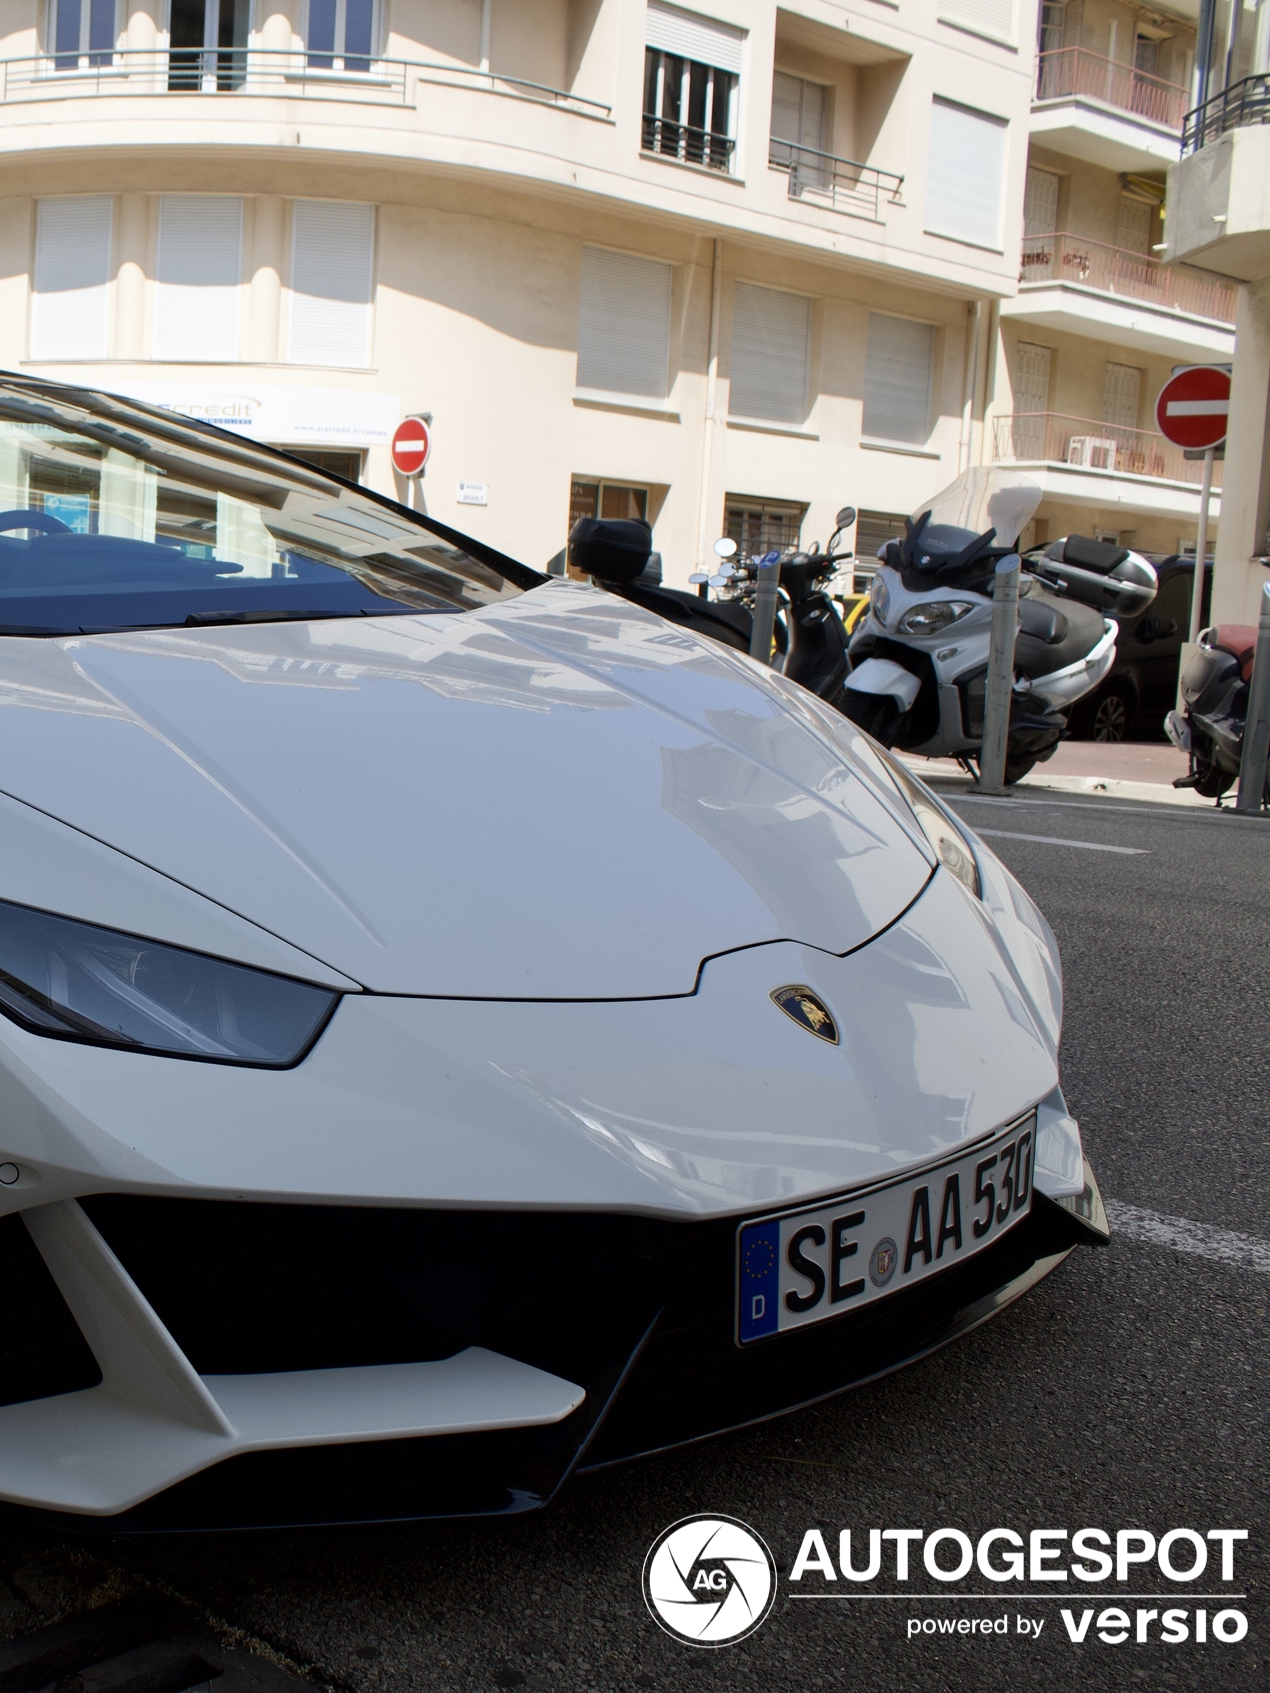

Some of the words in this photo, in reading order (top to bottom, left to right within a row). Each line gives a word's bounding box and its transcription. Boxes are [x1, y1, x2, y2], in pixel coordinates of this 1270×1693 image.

[785, 1209, 866, 1313] SE
[902, 1172, 963, 1275] AA
[972, 1129, 1032, 1239] 530
[752, 1294, 765, 1320] D
